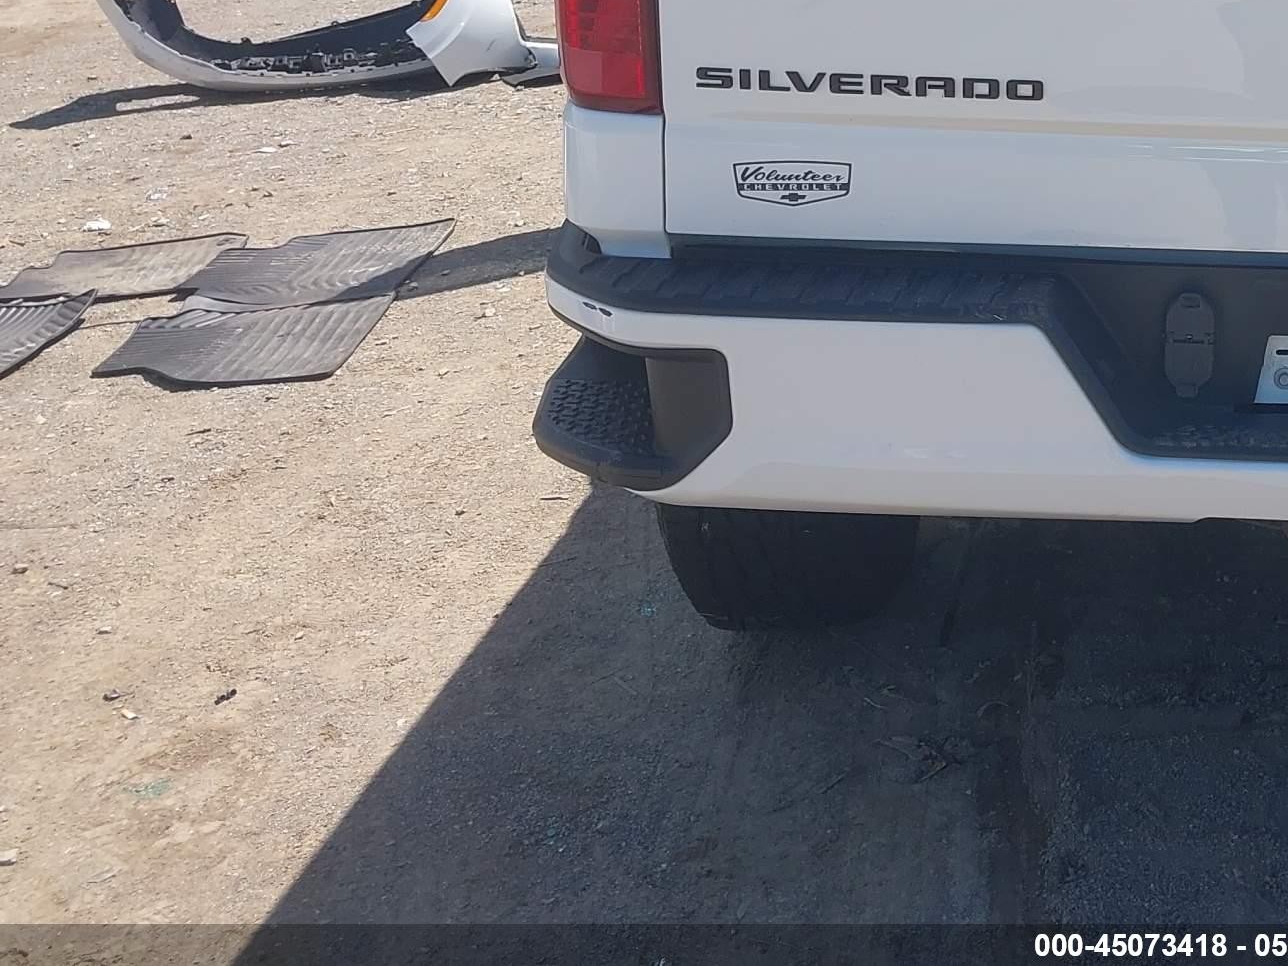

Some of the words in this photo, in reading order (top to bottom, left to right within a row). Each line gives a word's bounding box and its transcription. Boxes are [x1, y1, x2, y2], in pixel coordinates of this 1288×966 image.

[695, 66, 1044, 101] SILVERADO
[740, 166, 845, 182] Volunteer
[743, 183, 842, 191] CHEVROLET
